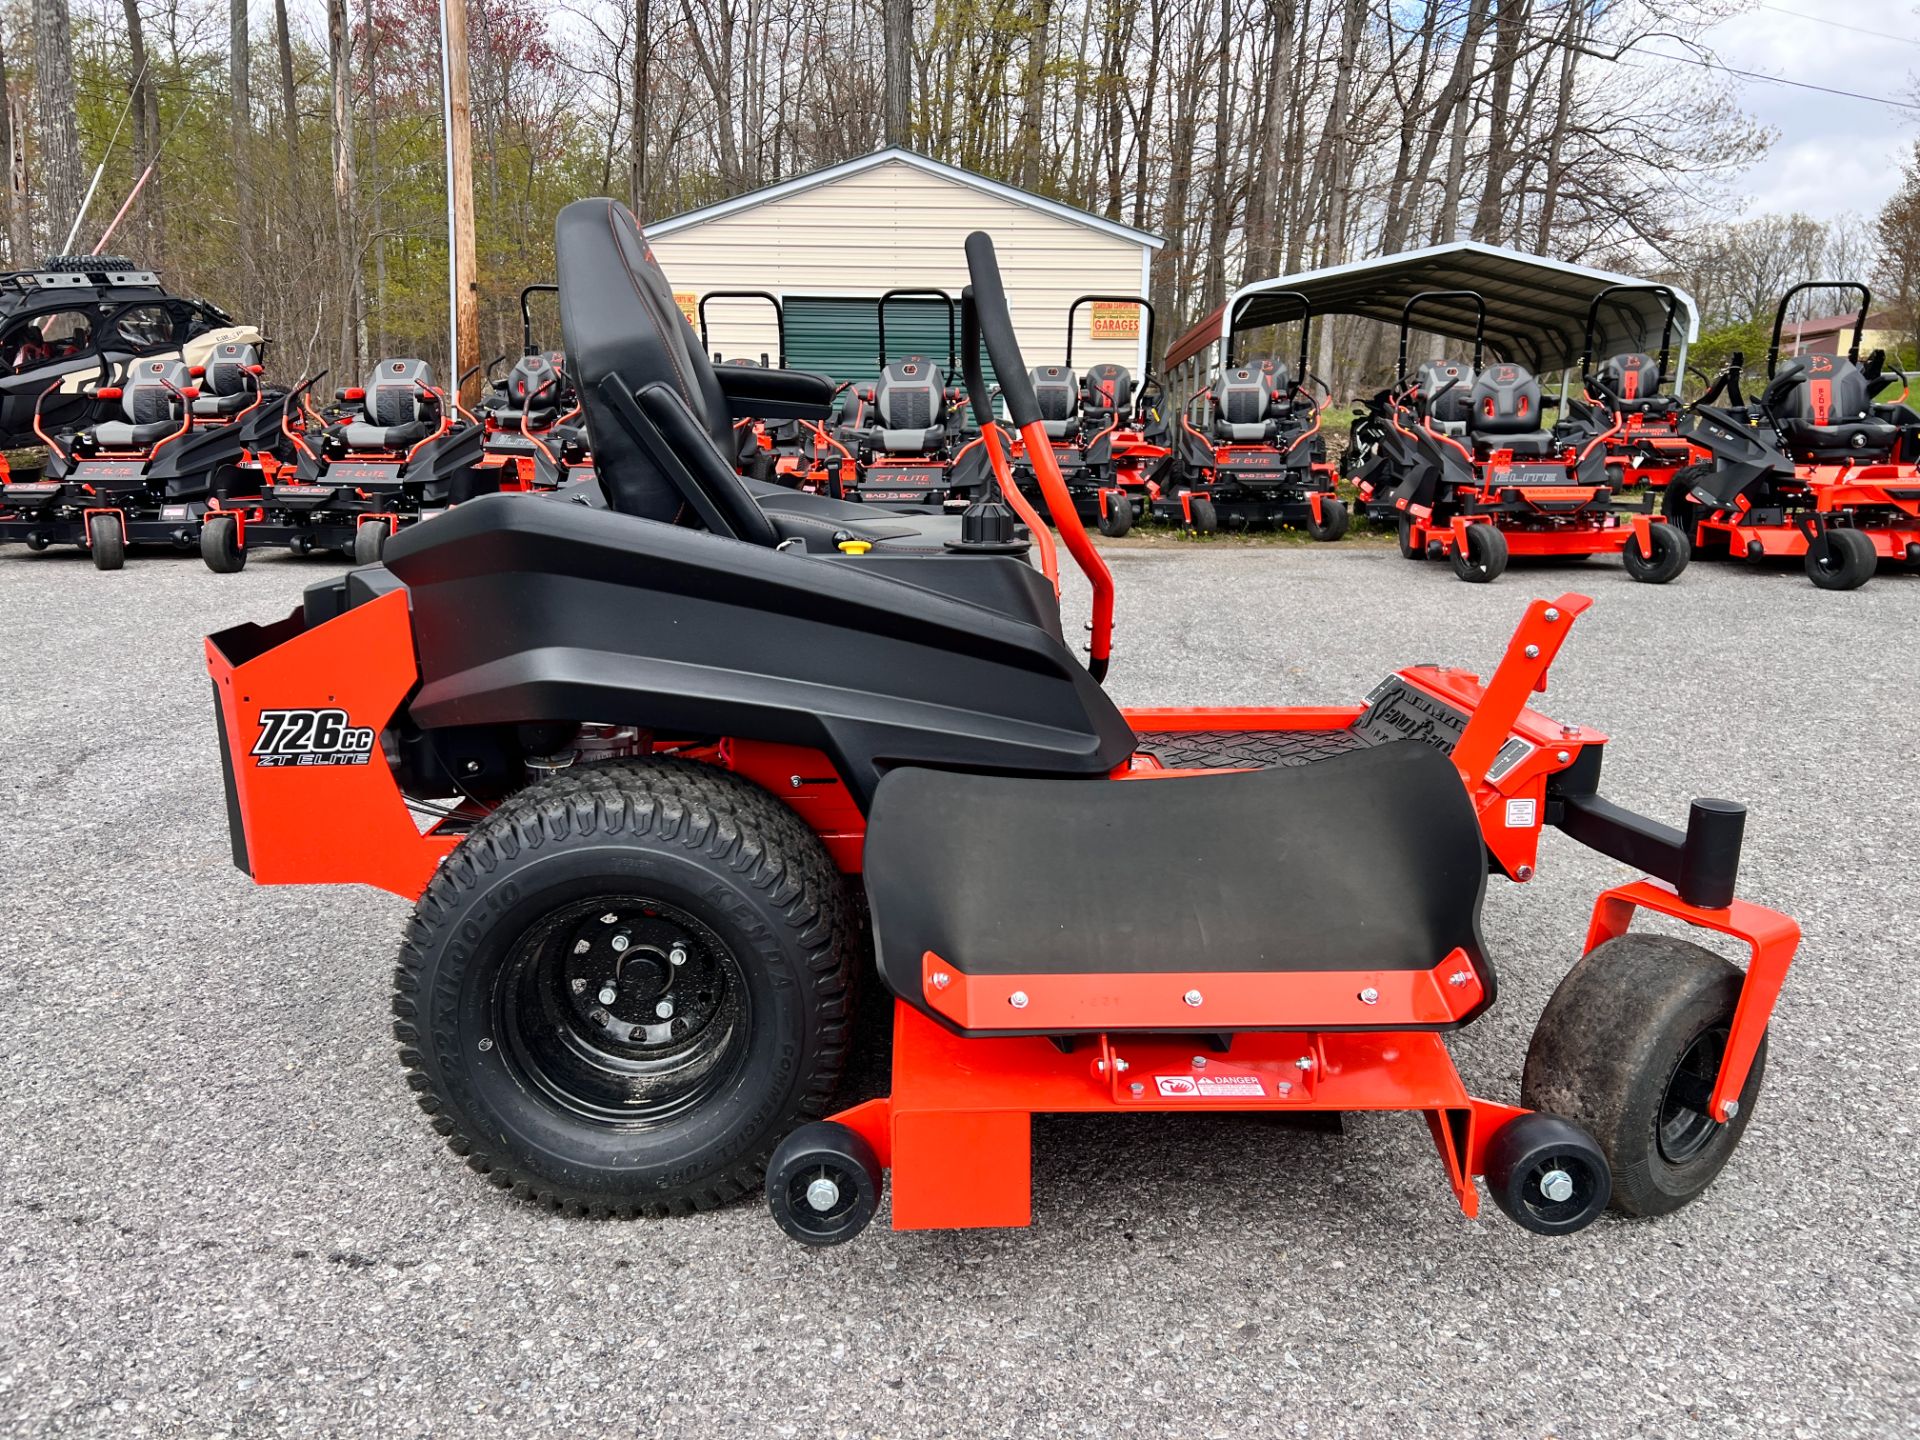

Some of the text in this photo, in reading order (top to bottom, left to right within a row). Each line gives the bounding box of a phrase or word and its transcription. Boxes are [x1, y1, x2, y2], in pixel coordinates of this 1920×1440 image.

[1095, 319, 1139, 330] GARAGES
[354, 469, 385, 478] ELITE
[875, 474, 930, 482] ZT ELITE
[1494, 473, 1557, 482] ELITE
[257, 753, 370, 766] ZT ELITE
[703, 881, 795, 990] KENDA
[1215, 1076, 1259, 1084] DANGER
[715, 1042, 795, 1158] COMMERCIAL
